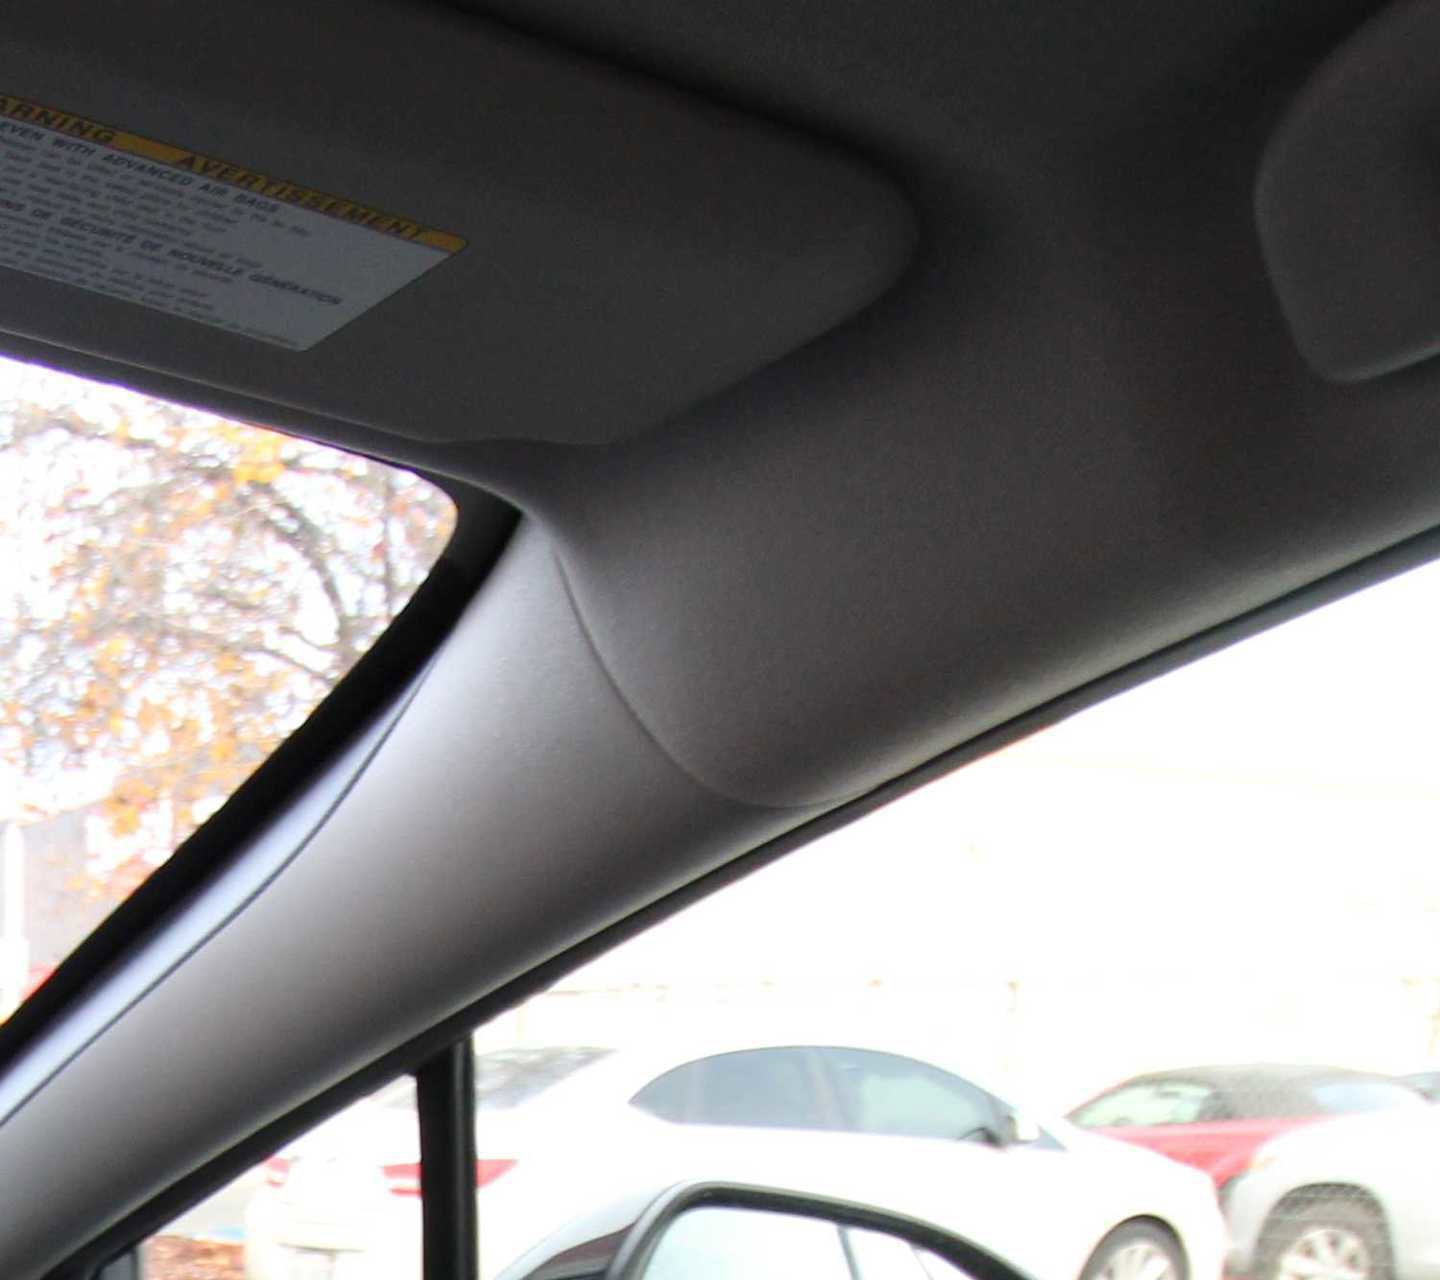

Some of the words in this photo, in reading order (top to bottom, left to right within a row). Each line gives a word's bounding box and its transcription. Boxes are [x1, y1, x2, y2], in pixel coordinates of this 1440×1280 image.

[49, 137, 97, 157] WITH
[100, 153, 194, 186] ADVANCED
[198, 182, 229, 198] AIR
[233, 193, 281, 213] BAGS
[178, 153, 424, 240] AVERTISSEMENT
[30, 208, 53, 220] DE
[139, 239, 163, 252] DE
